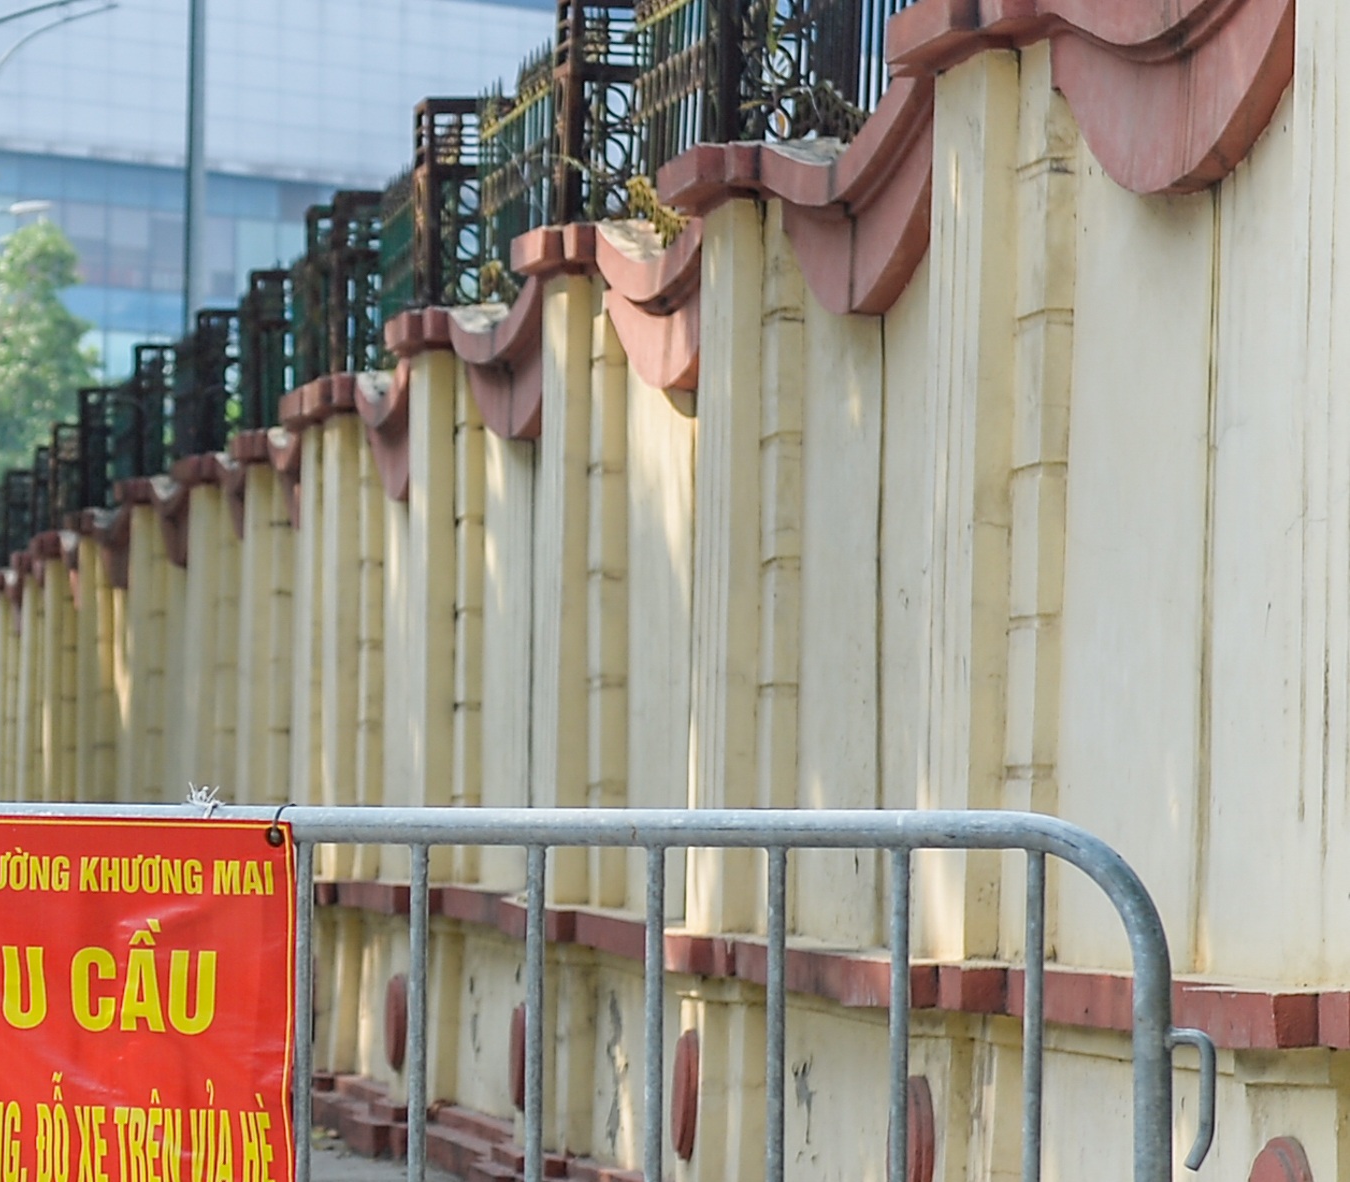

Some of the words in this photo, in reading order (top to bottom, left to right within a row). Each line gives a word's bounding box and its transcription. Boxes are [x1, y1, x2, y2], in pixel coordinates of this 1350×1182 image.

[79, 856, 203, 895] KHƯƠNG
[213, 860, 274, 896] MAI
[71, 919, 217, 1036] CẦU
